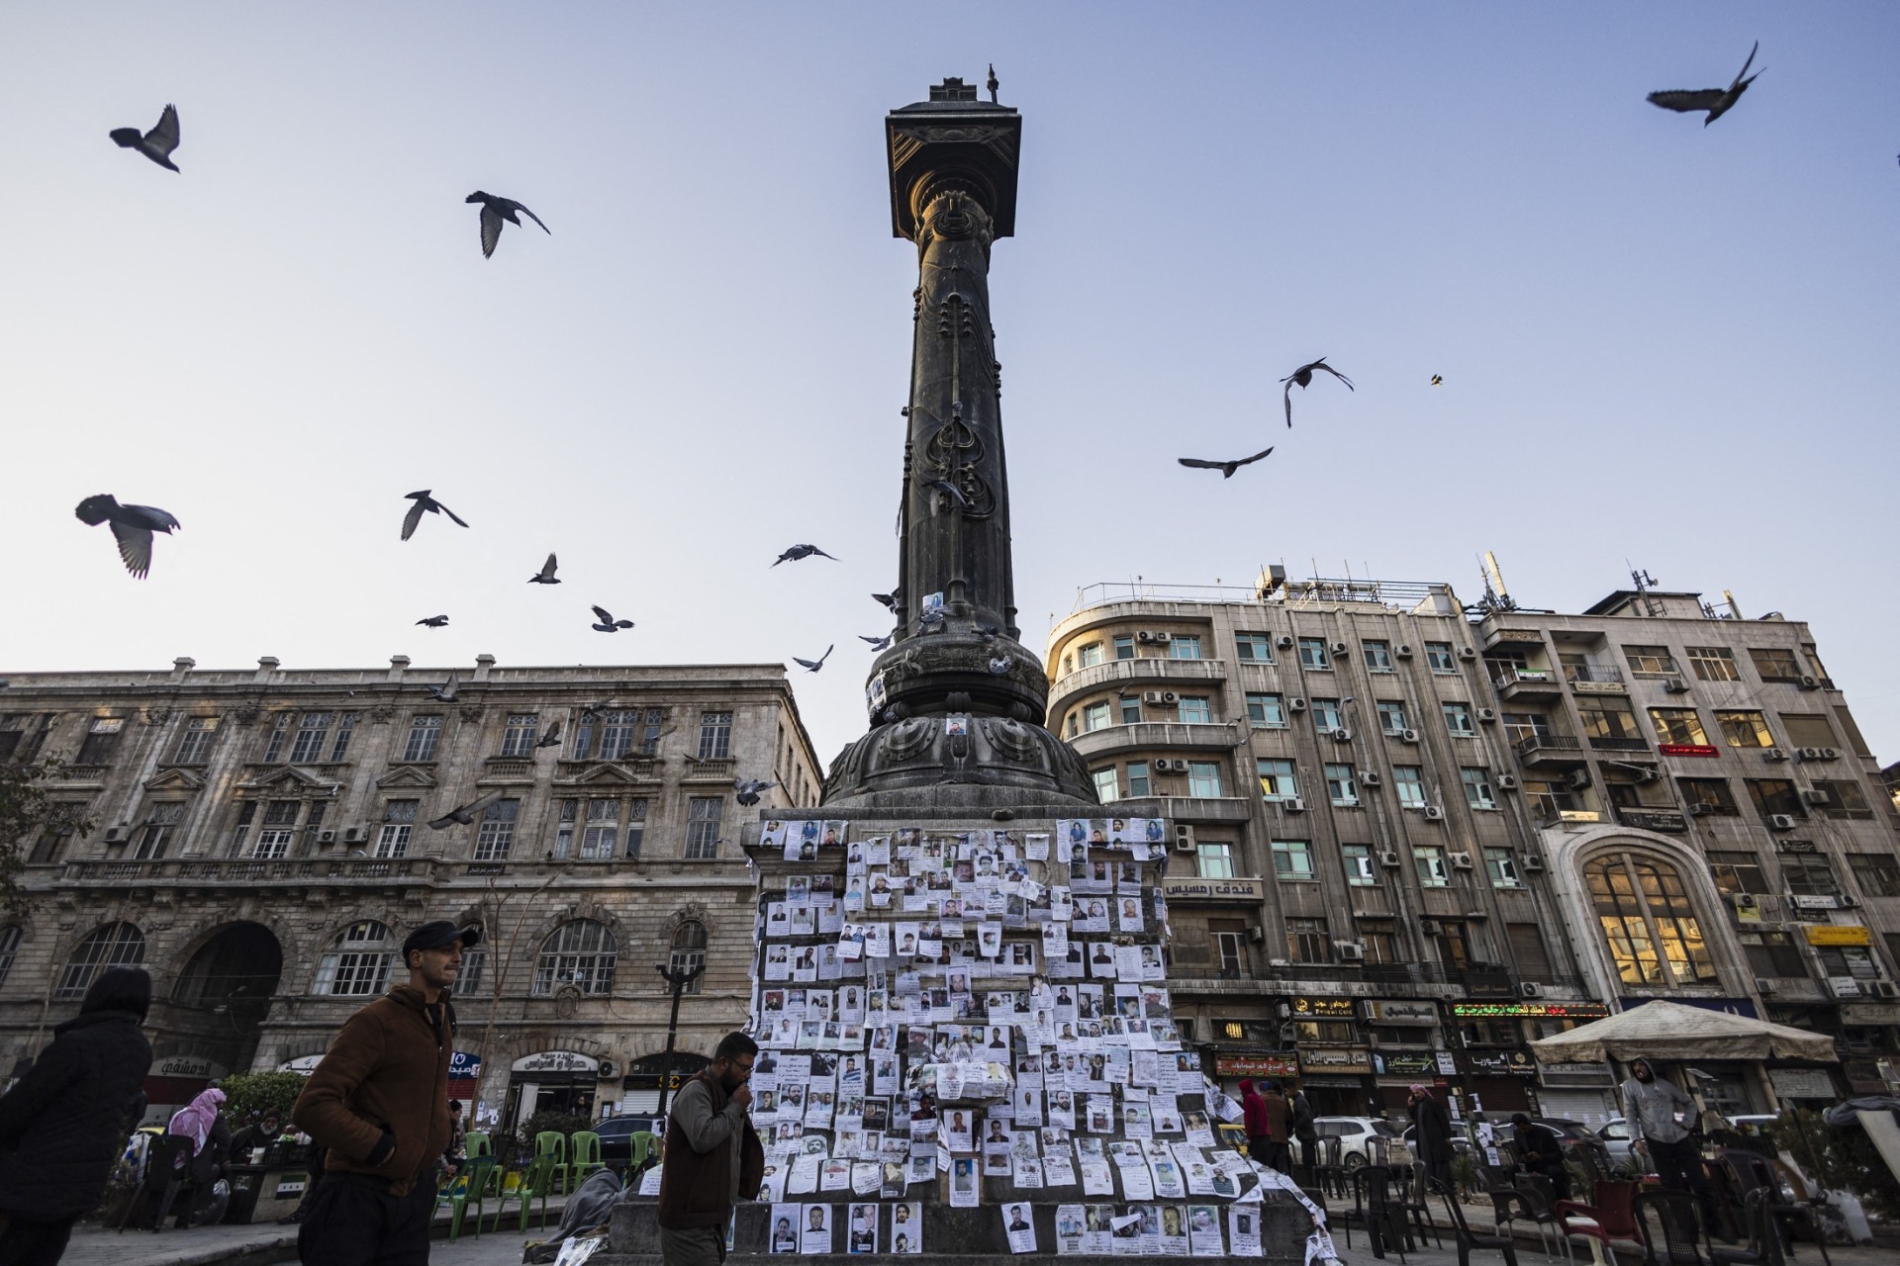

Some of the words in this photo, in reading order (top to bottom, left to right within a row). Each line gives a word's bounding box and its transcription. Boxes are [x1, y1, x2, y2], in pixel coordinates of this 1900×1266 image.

[1166, 884, 1213, 896] رمسيس
[1216, 883, 1254, 895] فندق
[524, 1058, 556, 1070] العباس
[1323, 1054, 1351, 1065] رمسيس
[1471, 1057, 1501, 1067] سوريا
[161, 1059, 212, 1076] الدمشقي
